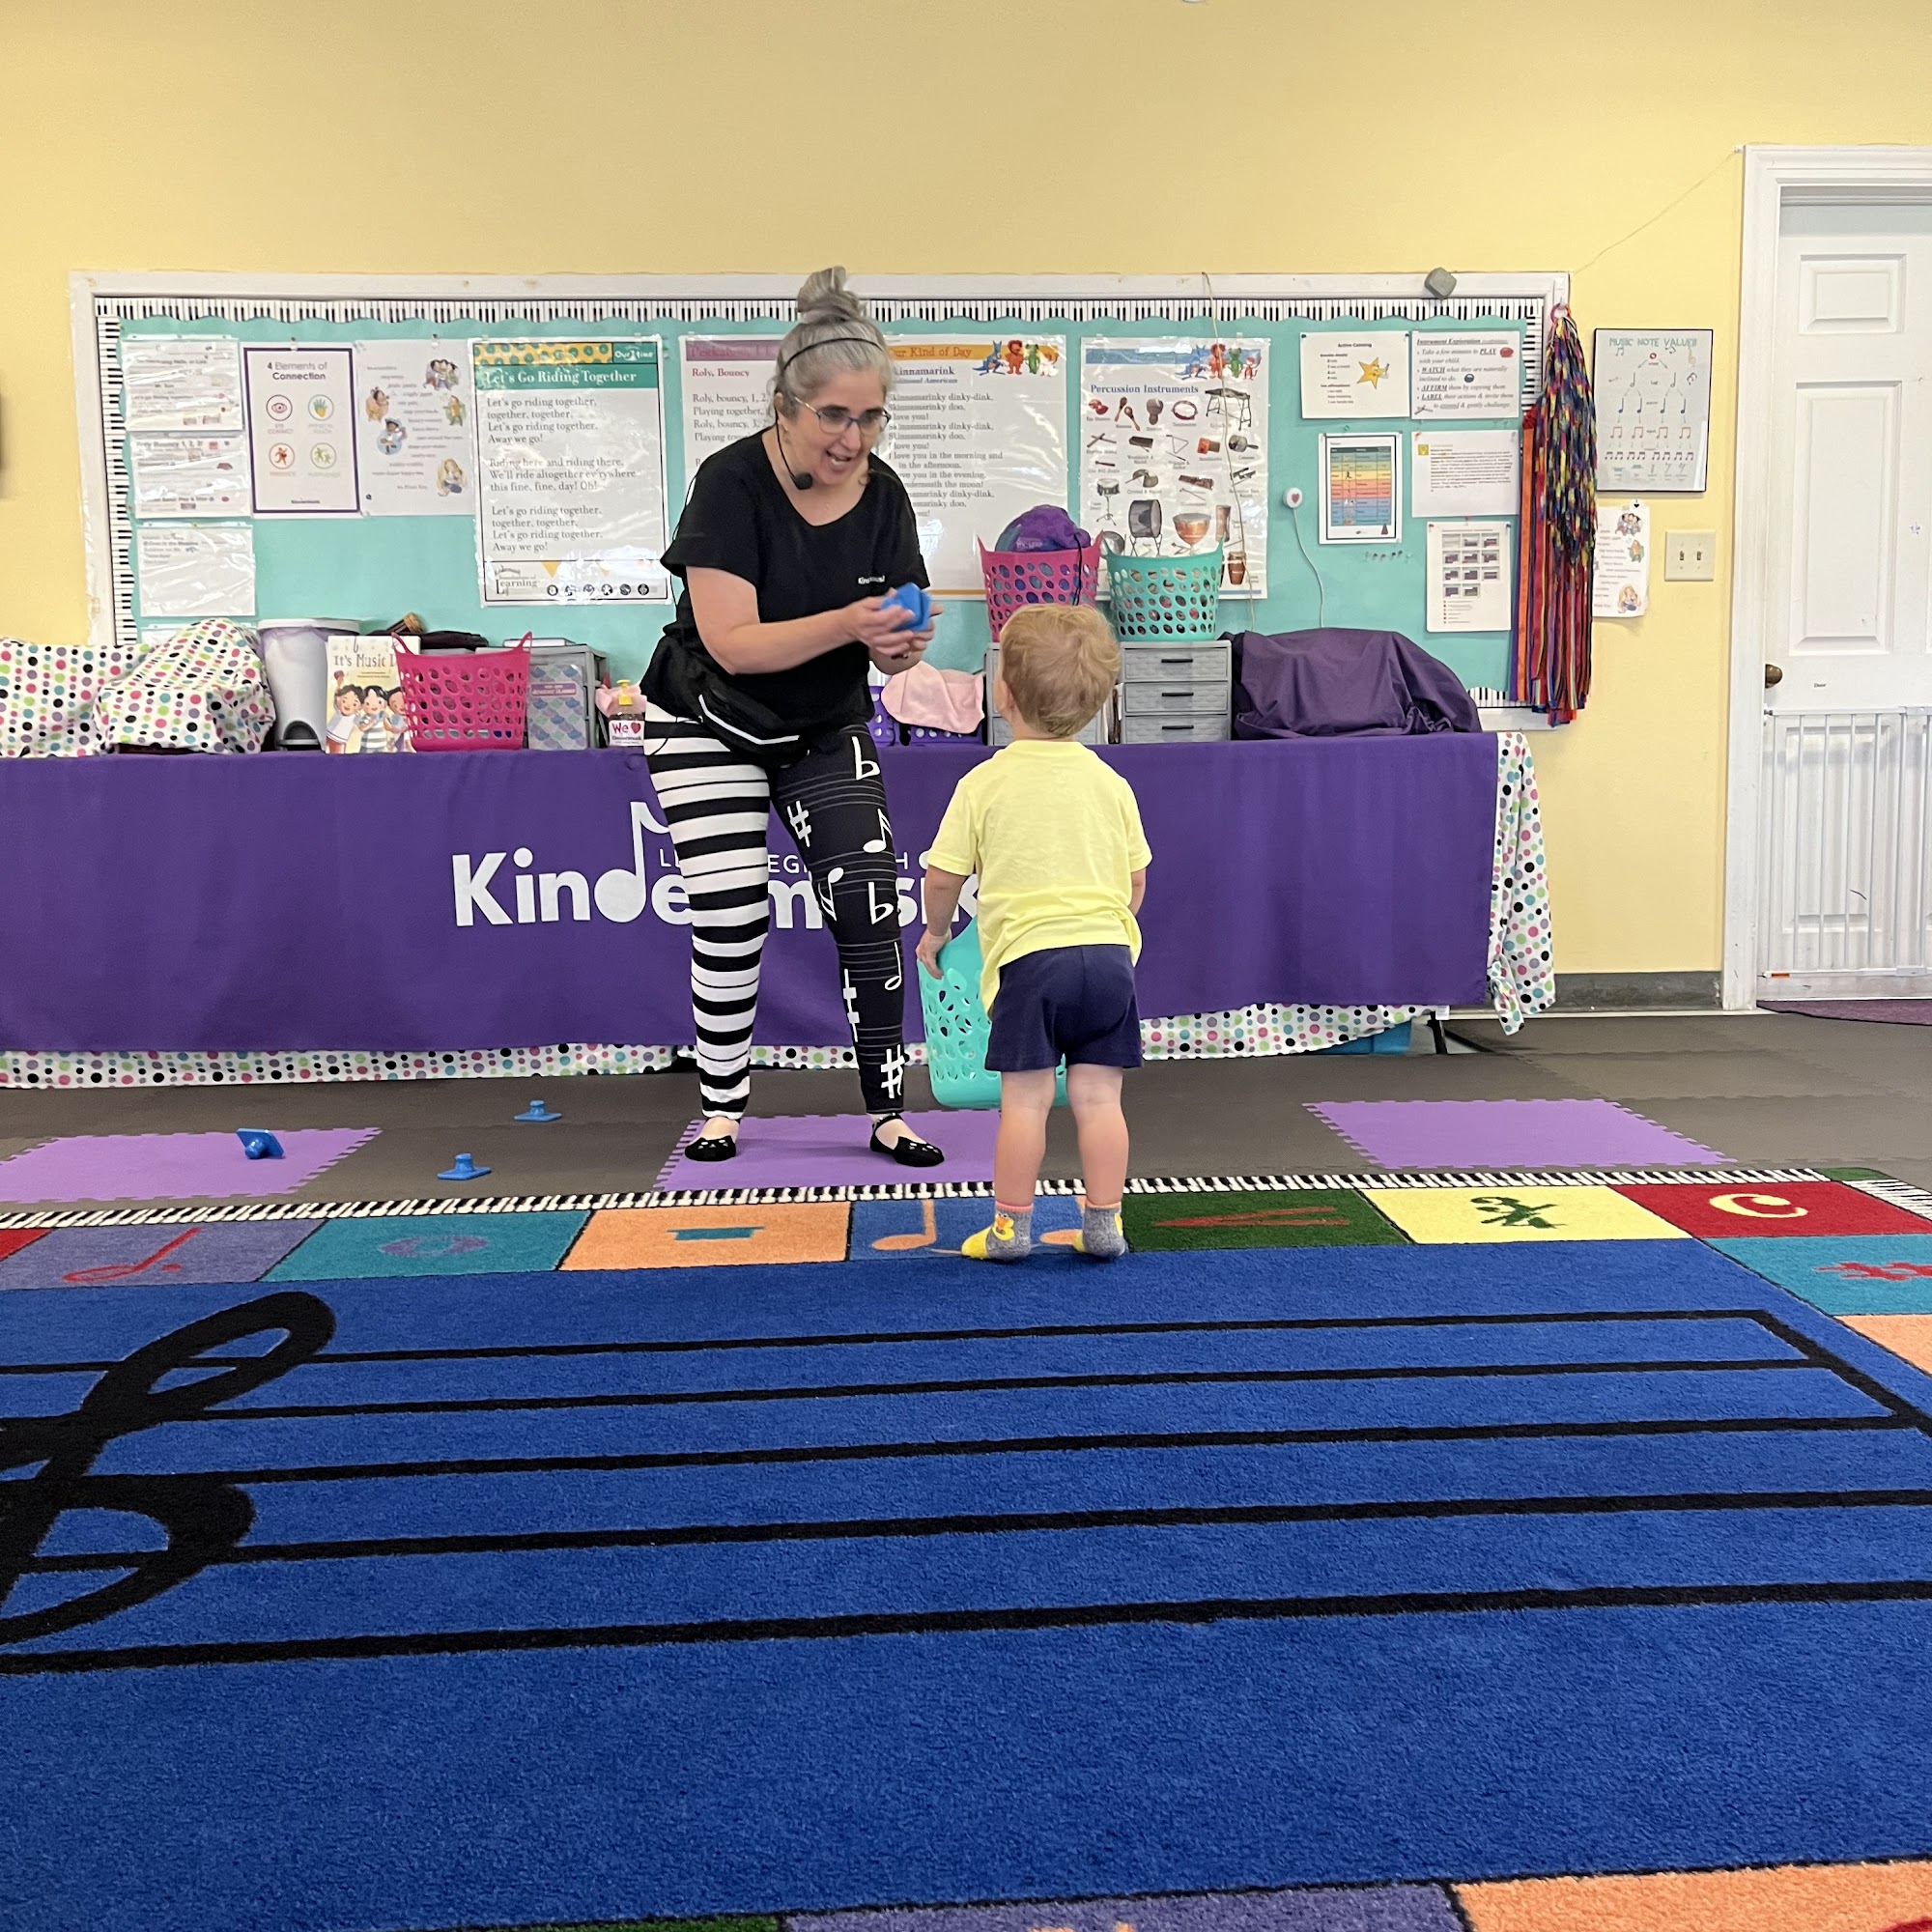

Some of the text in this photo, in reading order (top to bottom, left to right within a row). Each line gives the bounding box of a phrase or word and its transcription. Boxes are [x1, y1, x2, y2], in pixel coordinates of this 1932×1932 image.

[1609, 338, 1697, 346] MUSIC NOTE VALUES
[910, 348, 935, 357] Kind
[939, 348, 950, 356] of
[953, 347, 972, 357] Day
[718, 368, 750, 377] Bouncy
[894, 367, 955, 376] kinnamarink
[485, 370, 637, 386] Let's Go Riding Together
[1091, 384, 1199, 393] Percussion Instruments
[487, 398, 509, 407] Let's
[511, 400, 522, 409] go
[525, 396, 554, 408] riding
[693, 394, 713, 403] Roly,
[716, 394, 748, 403] bouncy,
[949, 393, 993, 402] dinky-dink,
[694, 407, 724, 417] Playing
[488, 422, 510, 431] Let's
[513, 425, 523, 433] go
[526, 421, 554, 432] riding
[694, 420, 715, 429] Roly,
[488, 435, 512, 444] Away
[528, 434, 543, 445] go!
[695, 433, 725, 442] Playing
[954, 452, 986, 461] morning
[490, 458, 521, 470] Riding
[523, 458, 543, 467] here
[546, 458, 563, 467] and
[566, 458, 595, 469] riding
[490, 470, 513, 479] We'll
[515, 470, 534, 479] ride
[537, 470, 583, 481] altogether
[490, 482, 597, 493] this fine, fine, day! Oh!
[492, 506, 514, 515] Let's
[529, 506, 559, 517] riding
[493, 530, 515, 539] Let's
[517, 533, 528, 541] go
[531, 530, 560, 541] riding
[493, 543, 517, 553] Away
[534, 542, 548, 552] go!
[333, 654, 386, 667] It's Music
[612, 722, 629, 734] We
